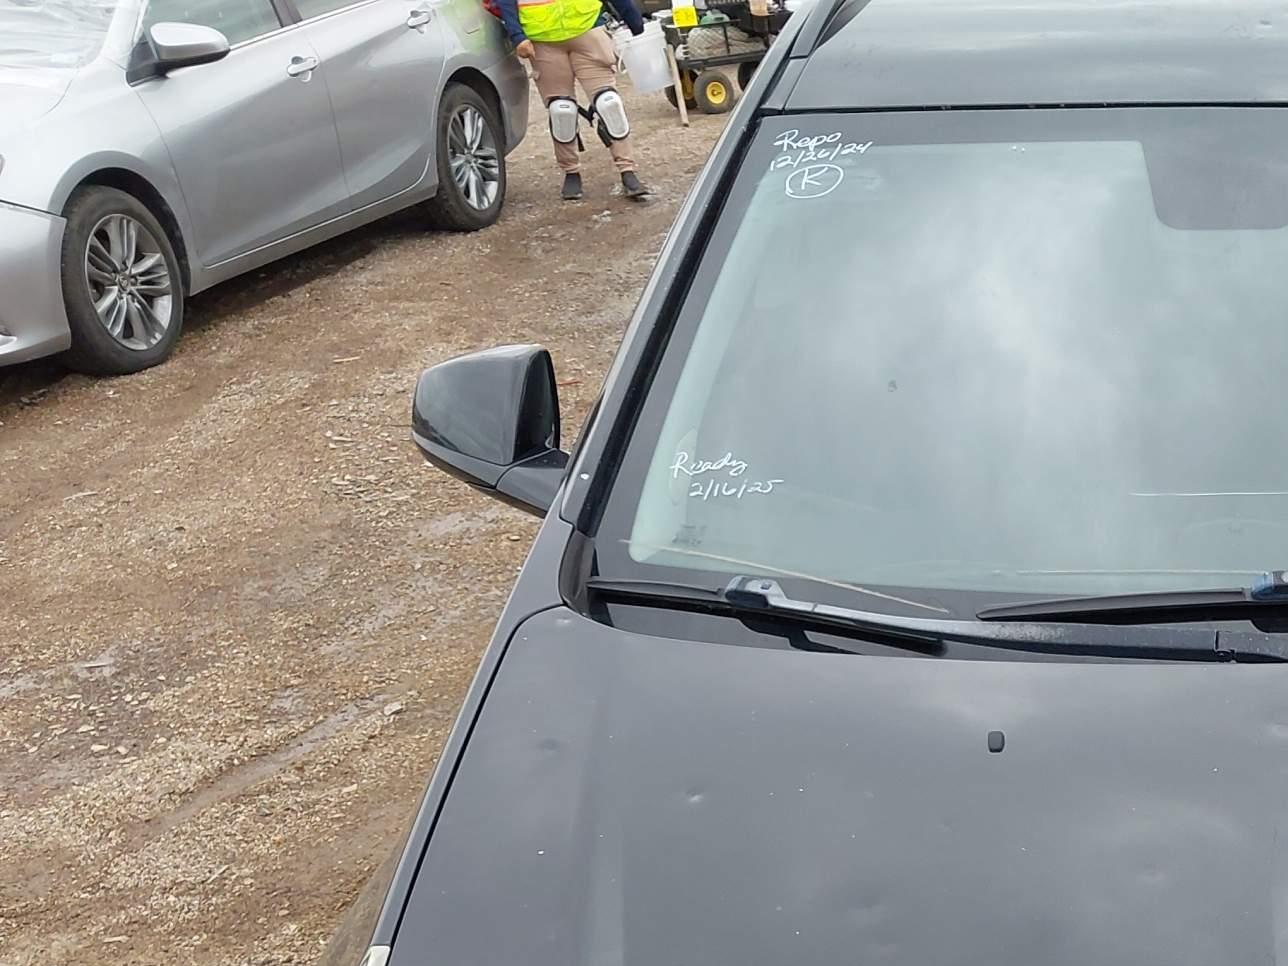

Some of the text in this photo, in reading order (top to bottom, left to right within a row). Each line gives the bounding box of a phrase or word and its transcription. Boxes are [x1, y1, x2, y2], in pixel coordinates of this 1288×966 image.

[773, 129, 842, 152] Repo
[769, 141, 873, 171] 12/26/24
[689, 479, 785, 500] 2/16/25
